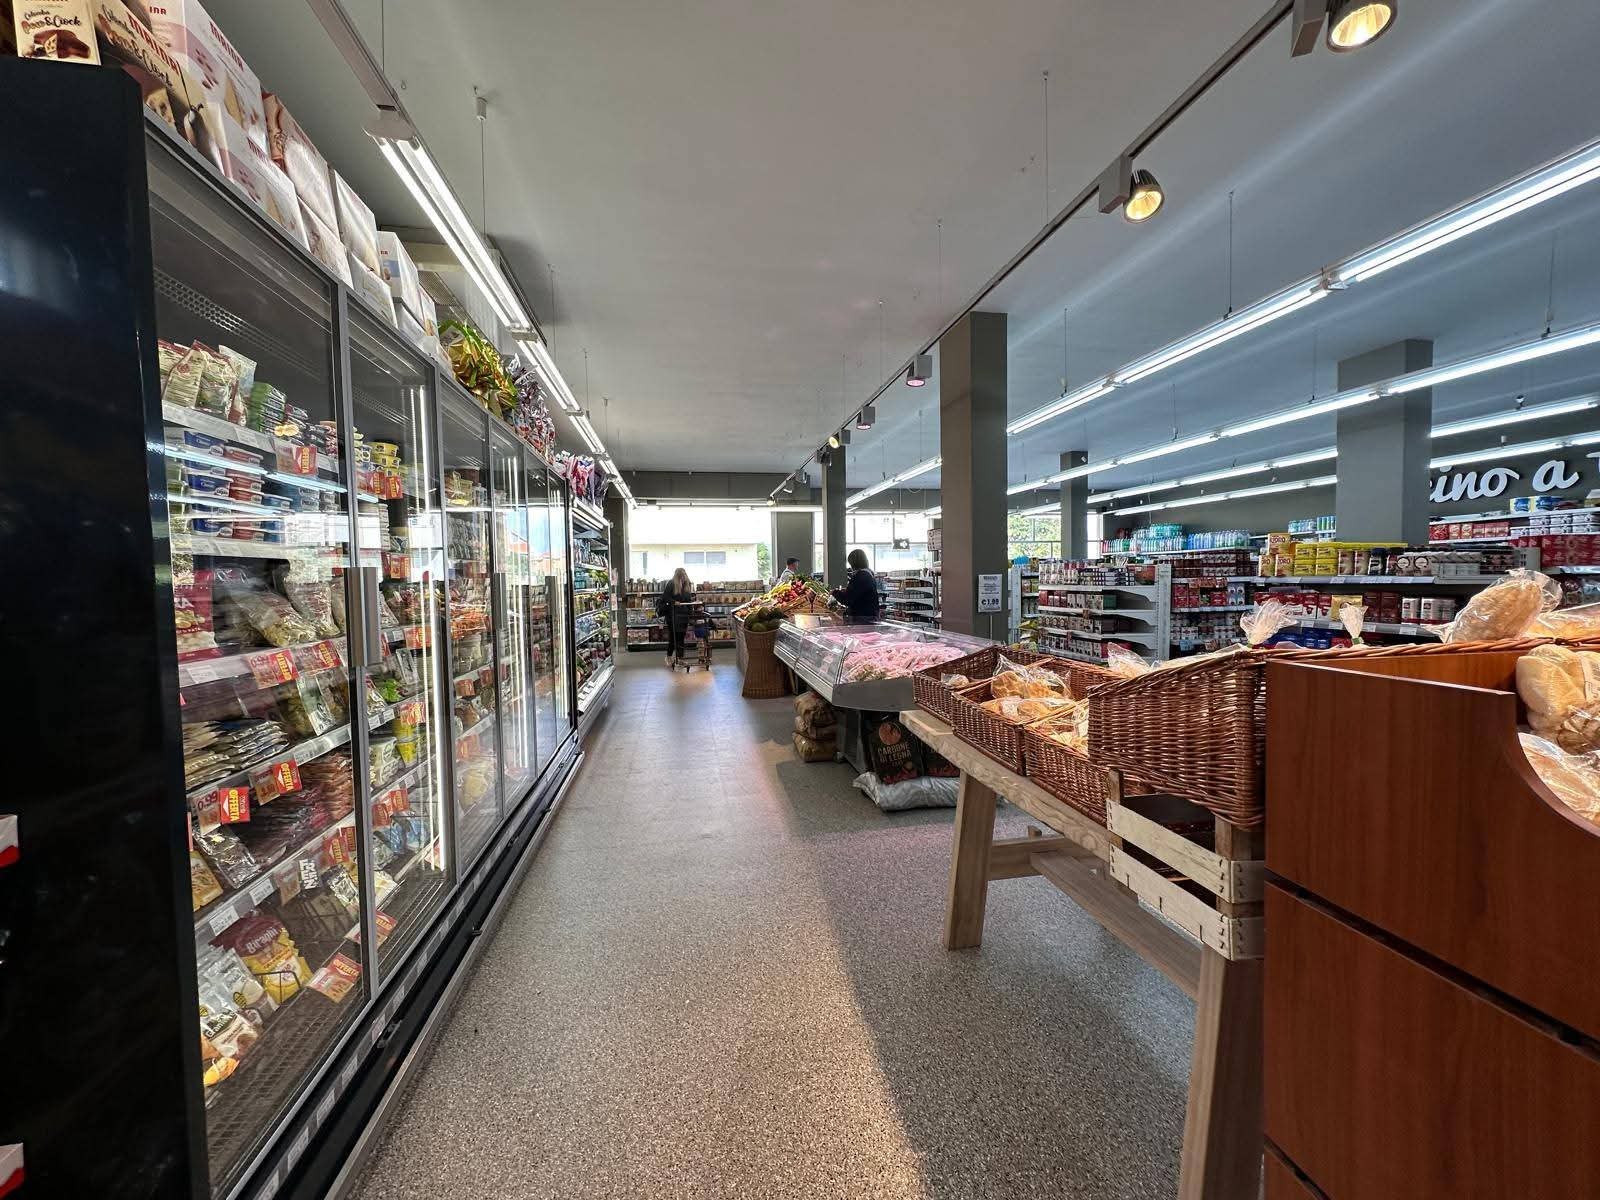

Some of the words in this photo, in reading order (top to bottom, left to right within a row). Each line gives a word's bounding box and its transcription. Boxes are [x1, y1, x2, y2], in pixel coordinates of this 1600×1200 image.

[301, 447, 310, 474] OFFERTA
[1430, 465, 1520, 503] ino
[1532, 459, 1580, 493] a
[276, 652, 292, 681] OFFERTA
[281, 762, 294, 791] OFFERTA
[229, 789, 240, 822] OFFERTA
[332, 838, 344, 863] OFFERTA
